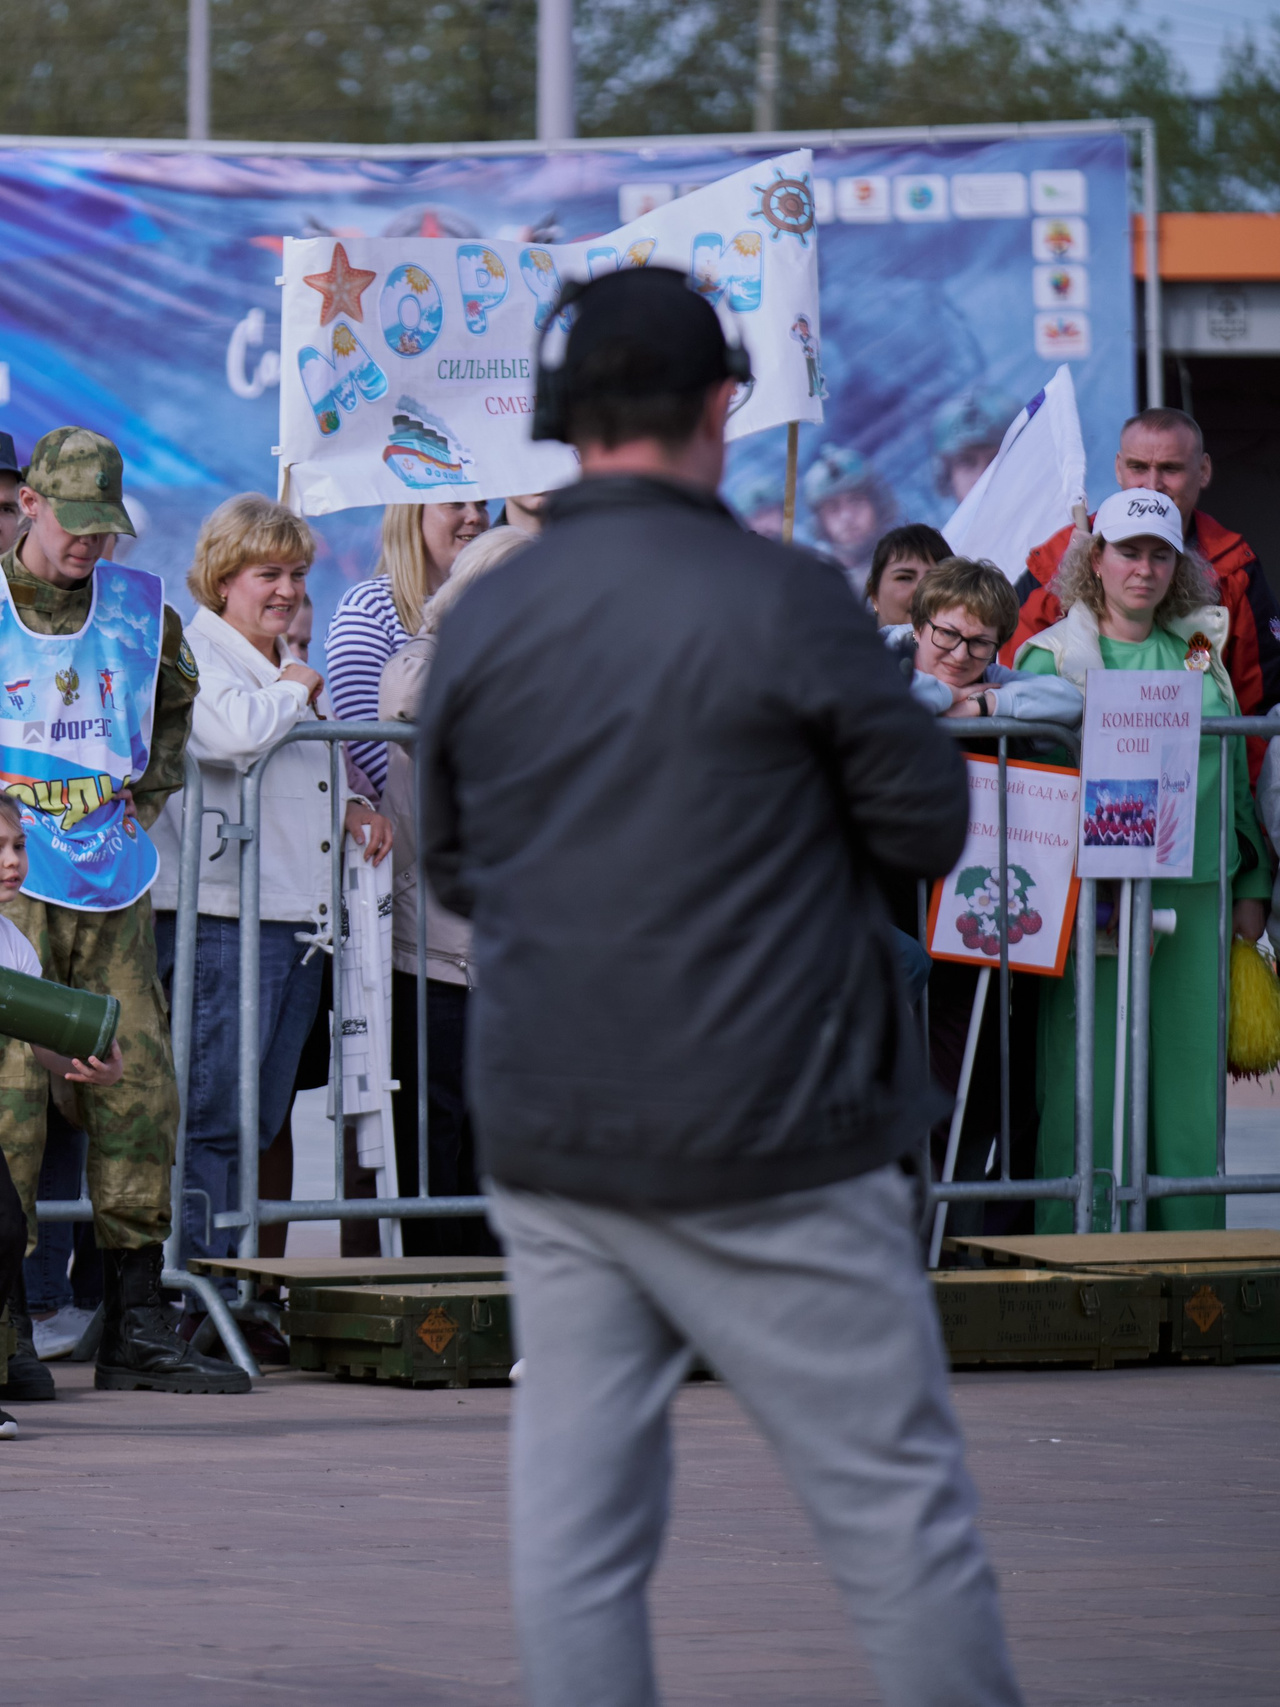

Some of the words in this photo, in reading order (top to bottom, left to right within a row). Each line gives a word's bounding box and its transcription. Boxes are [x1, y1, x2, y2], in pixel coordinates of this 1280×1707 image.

[437, 359, 530, 380] СИЛЬНЫЕ
[1127, 498, 1170, 518] Буды
[1140, 685, 1181, 701] МАОУ
[1101, 712, 1190, 728] КОМЕНСКАЯ
[51, 718, 112, 742] ФОРЭС
[1116, 738, 1150, 753] СОШ
[1028, 784, 1053, 801] САД
[1055, 789, 1070, 801] №
